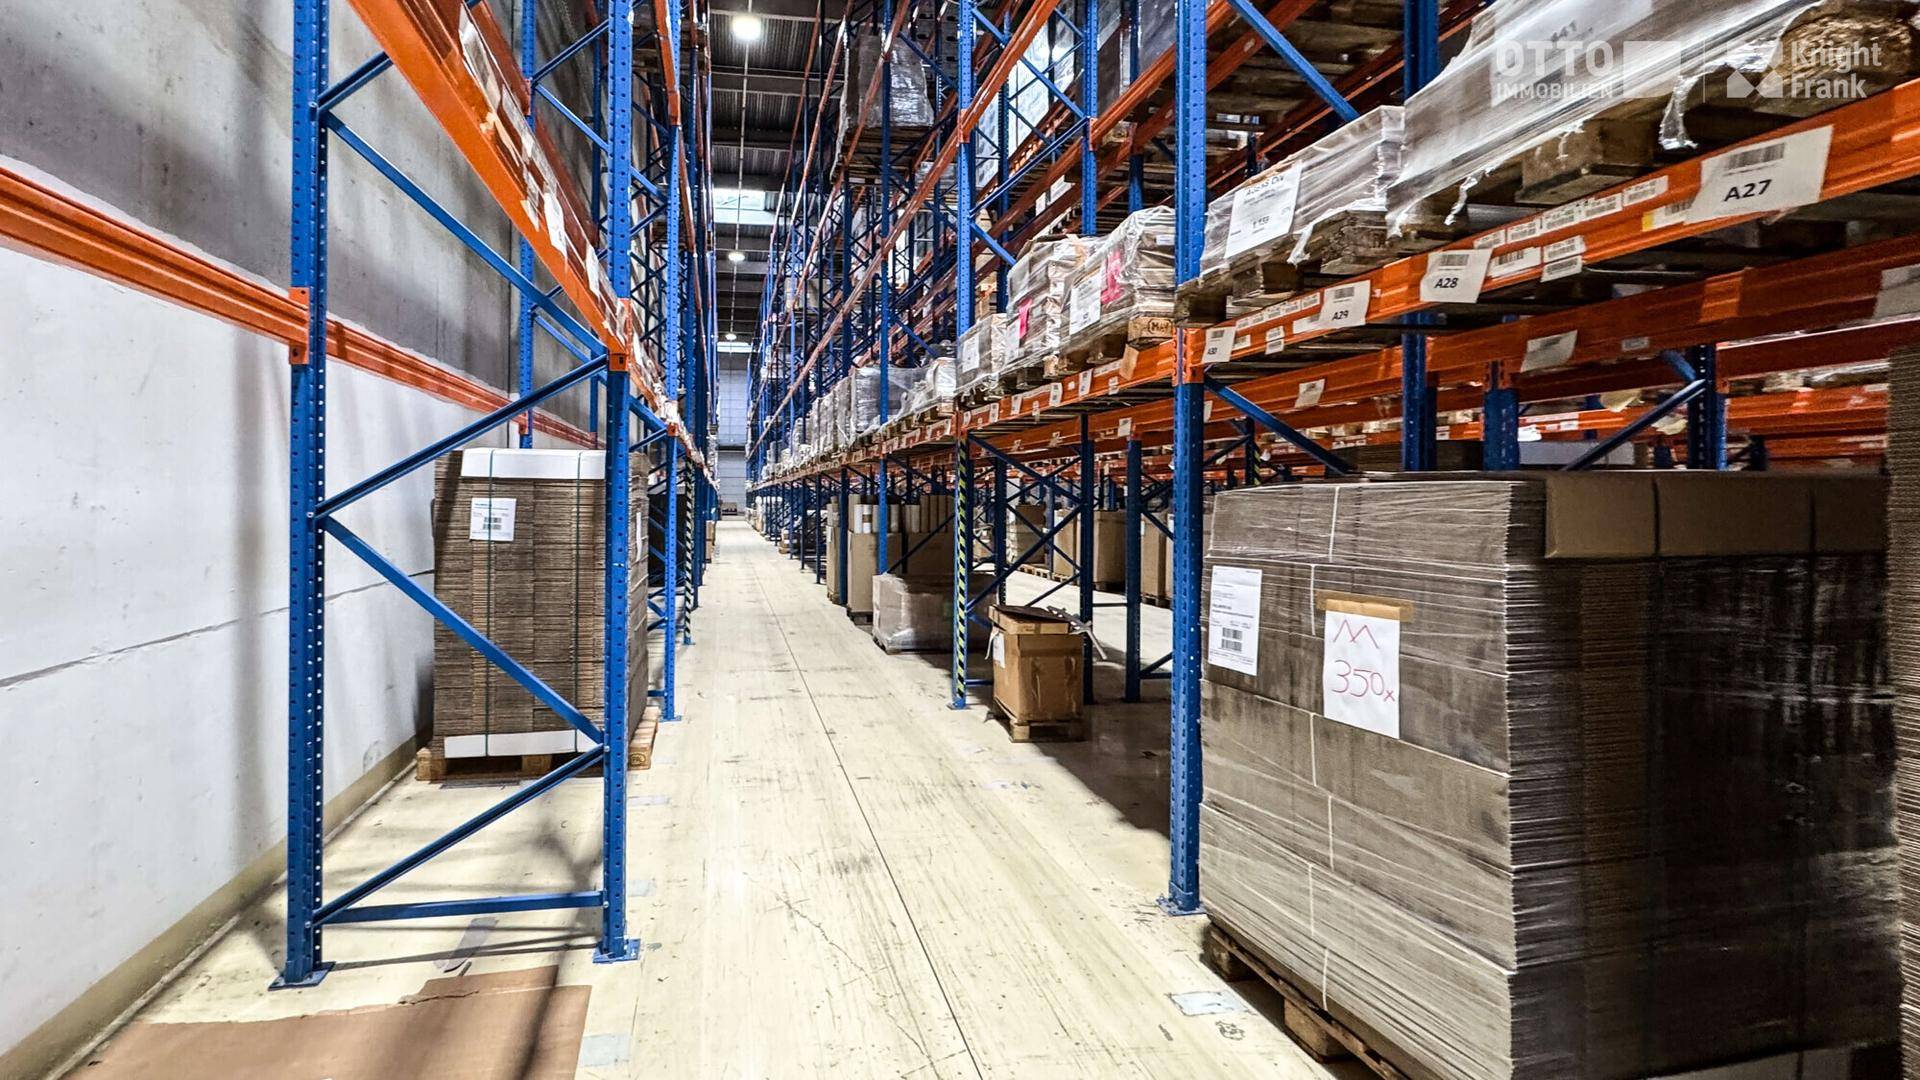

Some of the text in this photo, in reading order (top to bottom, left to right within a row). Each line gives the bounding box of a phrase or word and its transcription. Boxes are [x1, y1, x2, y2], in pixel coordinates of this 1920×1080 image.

[1723, 178, 1773, 202] A27
[1433, 277, 1459, 289] A28
[1331, 310, 1349, 321] A29
[1333, 619, 1379, 649] M
[1331, 659, 1396, 702] 350x
